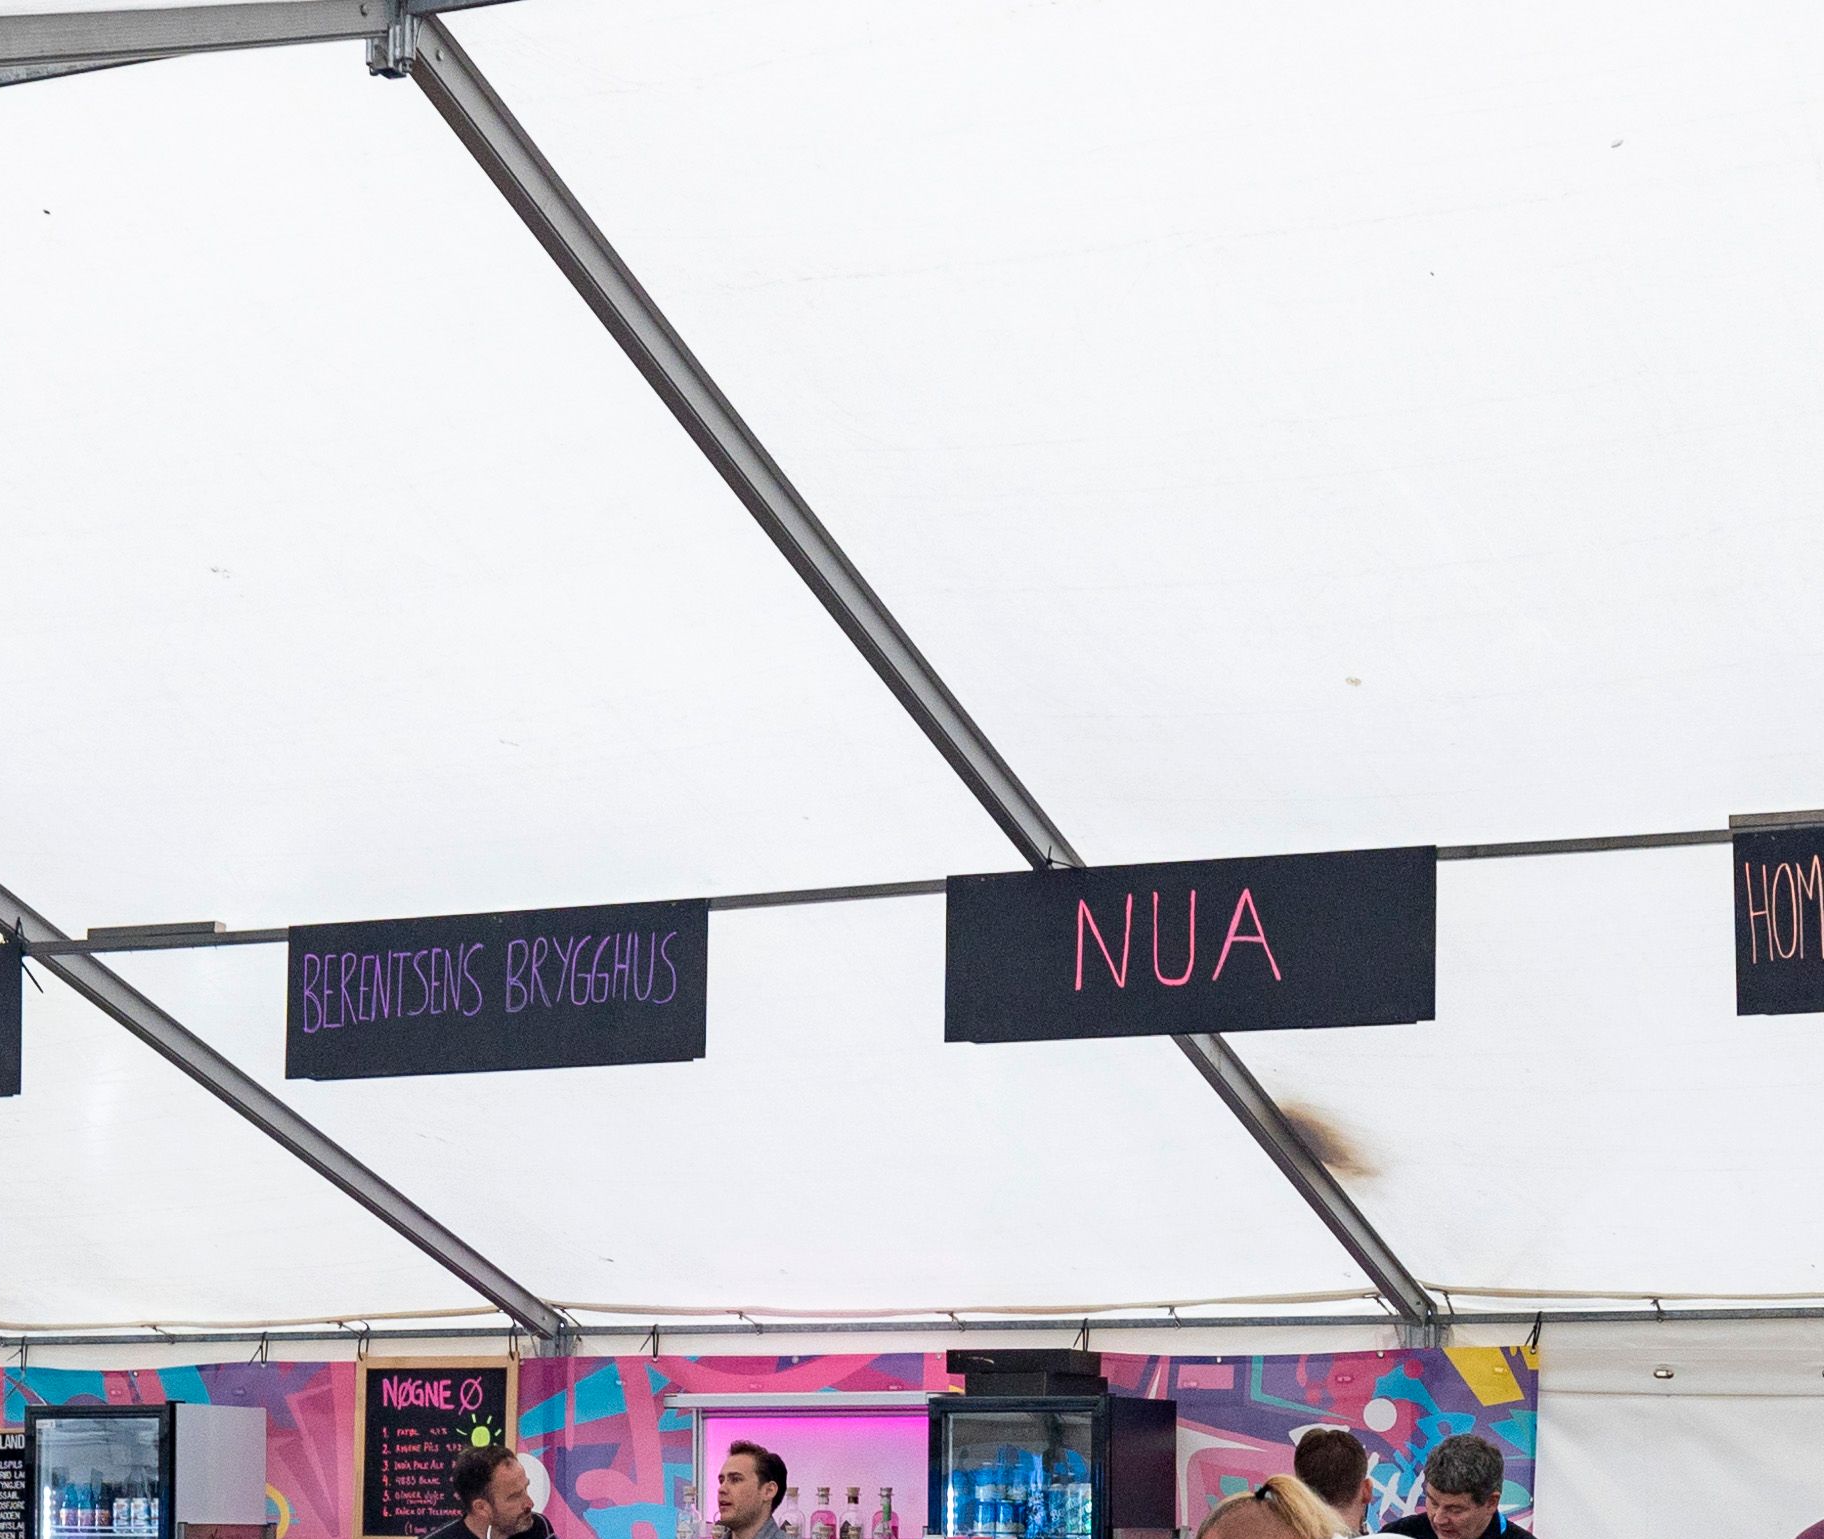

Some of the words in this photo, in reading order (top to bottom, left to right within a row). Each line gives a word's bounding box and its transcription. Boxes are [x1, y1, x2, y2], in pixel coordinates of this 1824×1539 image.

[302, 944, 482, 1033] BERENTSENS
[504, 930, 679, 1012] BRYGGHUS
[1074, 886, 1282, 991] NUA
[382, 1375, 455, 1410] NØGNE
[458, 1376, 483, 1416] Ø
